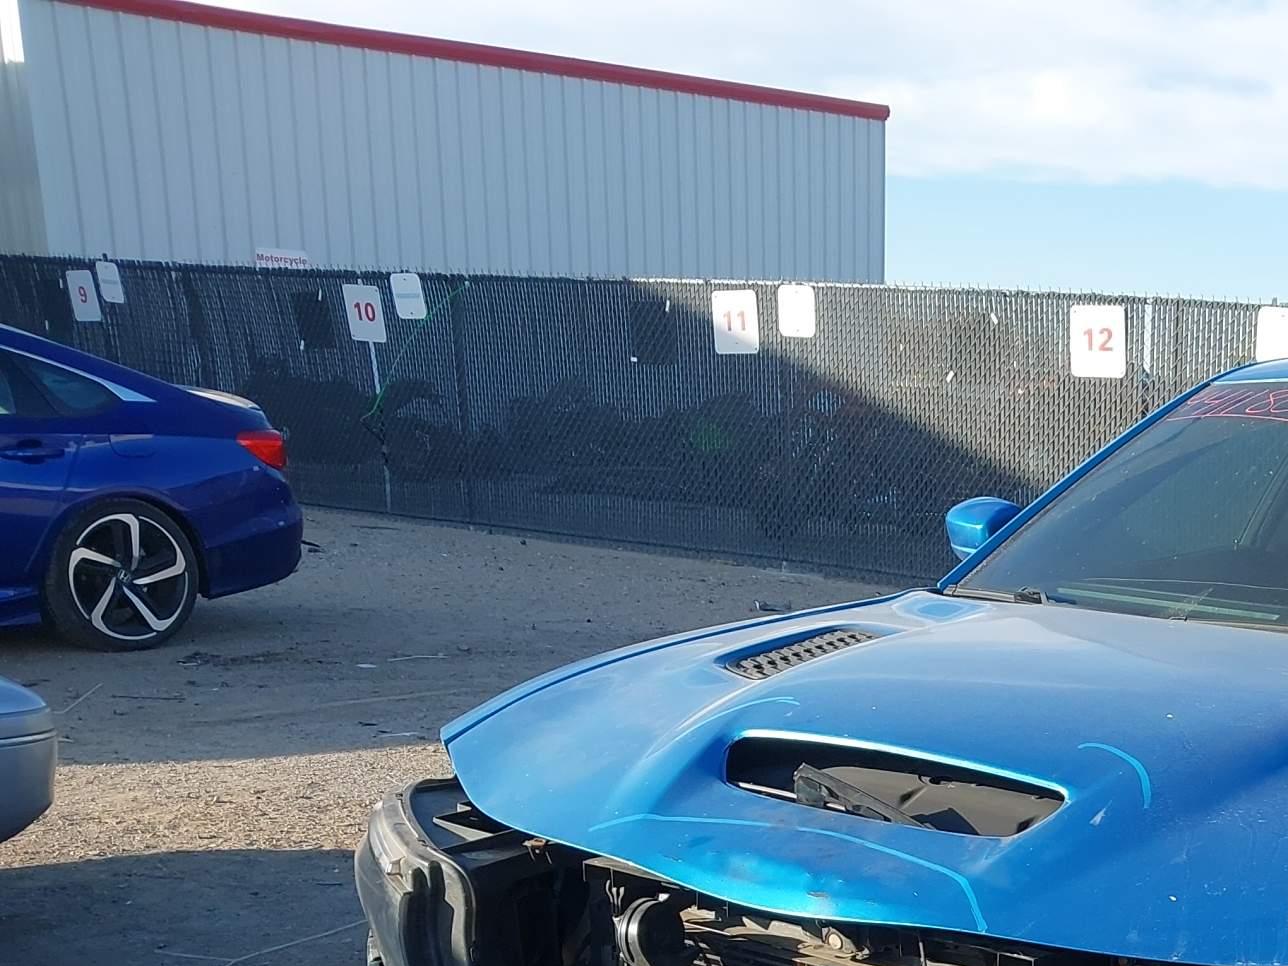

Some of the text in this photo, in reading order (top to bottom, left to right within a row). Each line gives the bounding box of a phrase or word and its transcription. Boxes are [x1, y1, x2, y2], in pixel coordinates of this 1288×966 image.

[256, 253, 308, 266] Motorcycle
[78, 286, 88, 304] 9
[353, 301, 377, 322] 10
[723, 310, 747, 332] 11
[1083, 327, 1114, 352] 12
